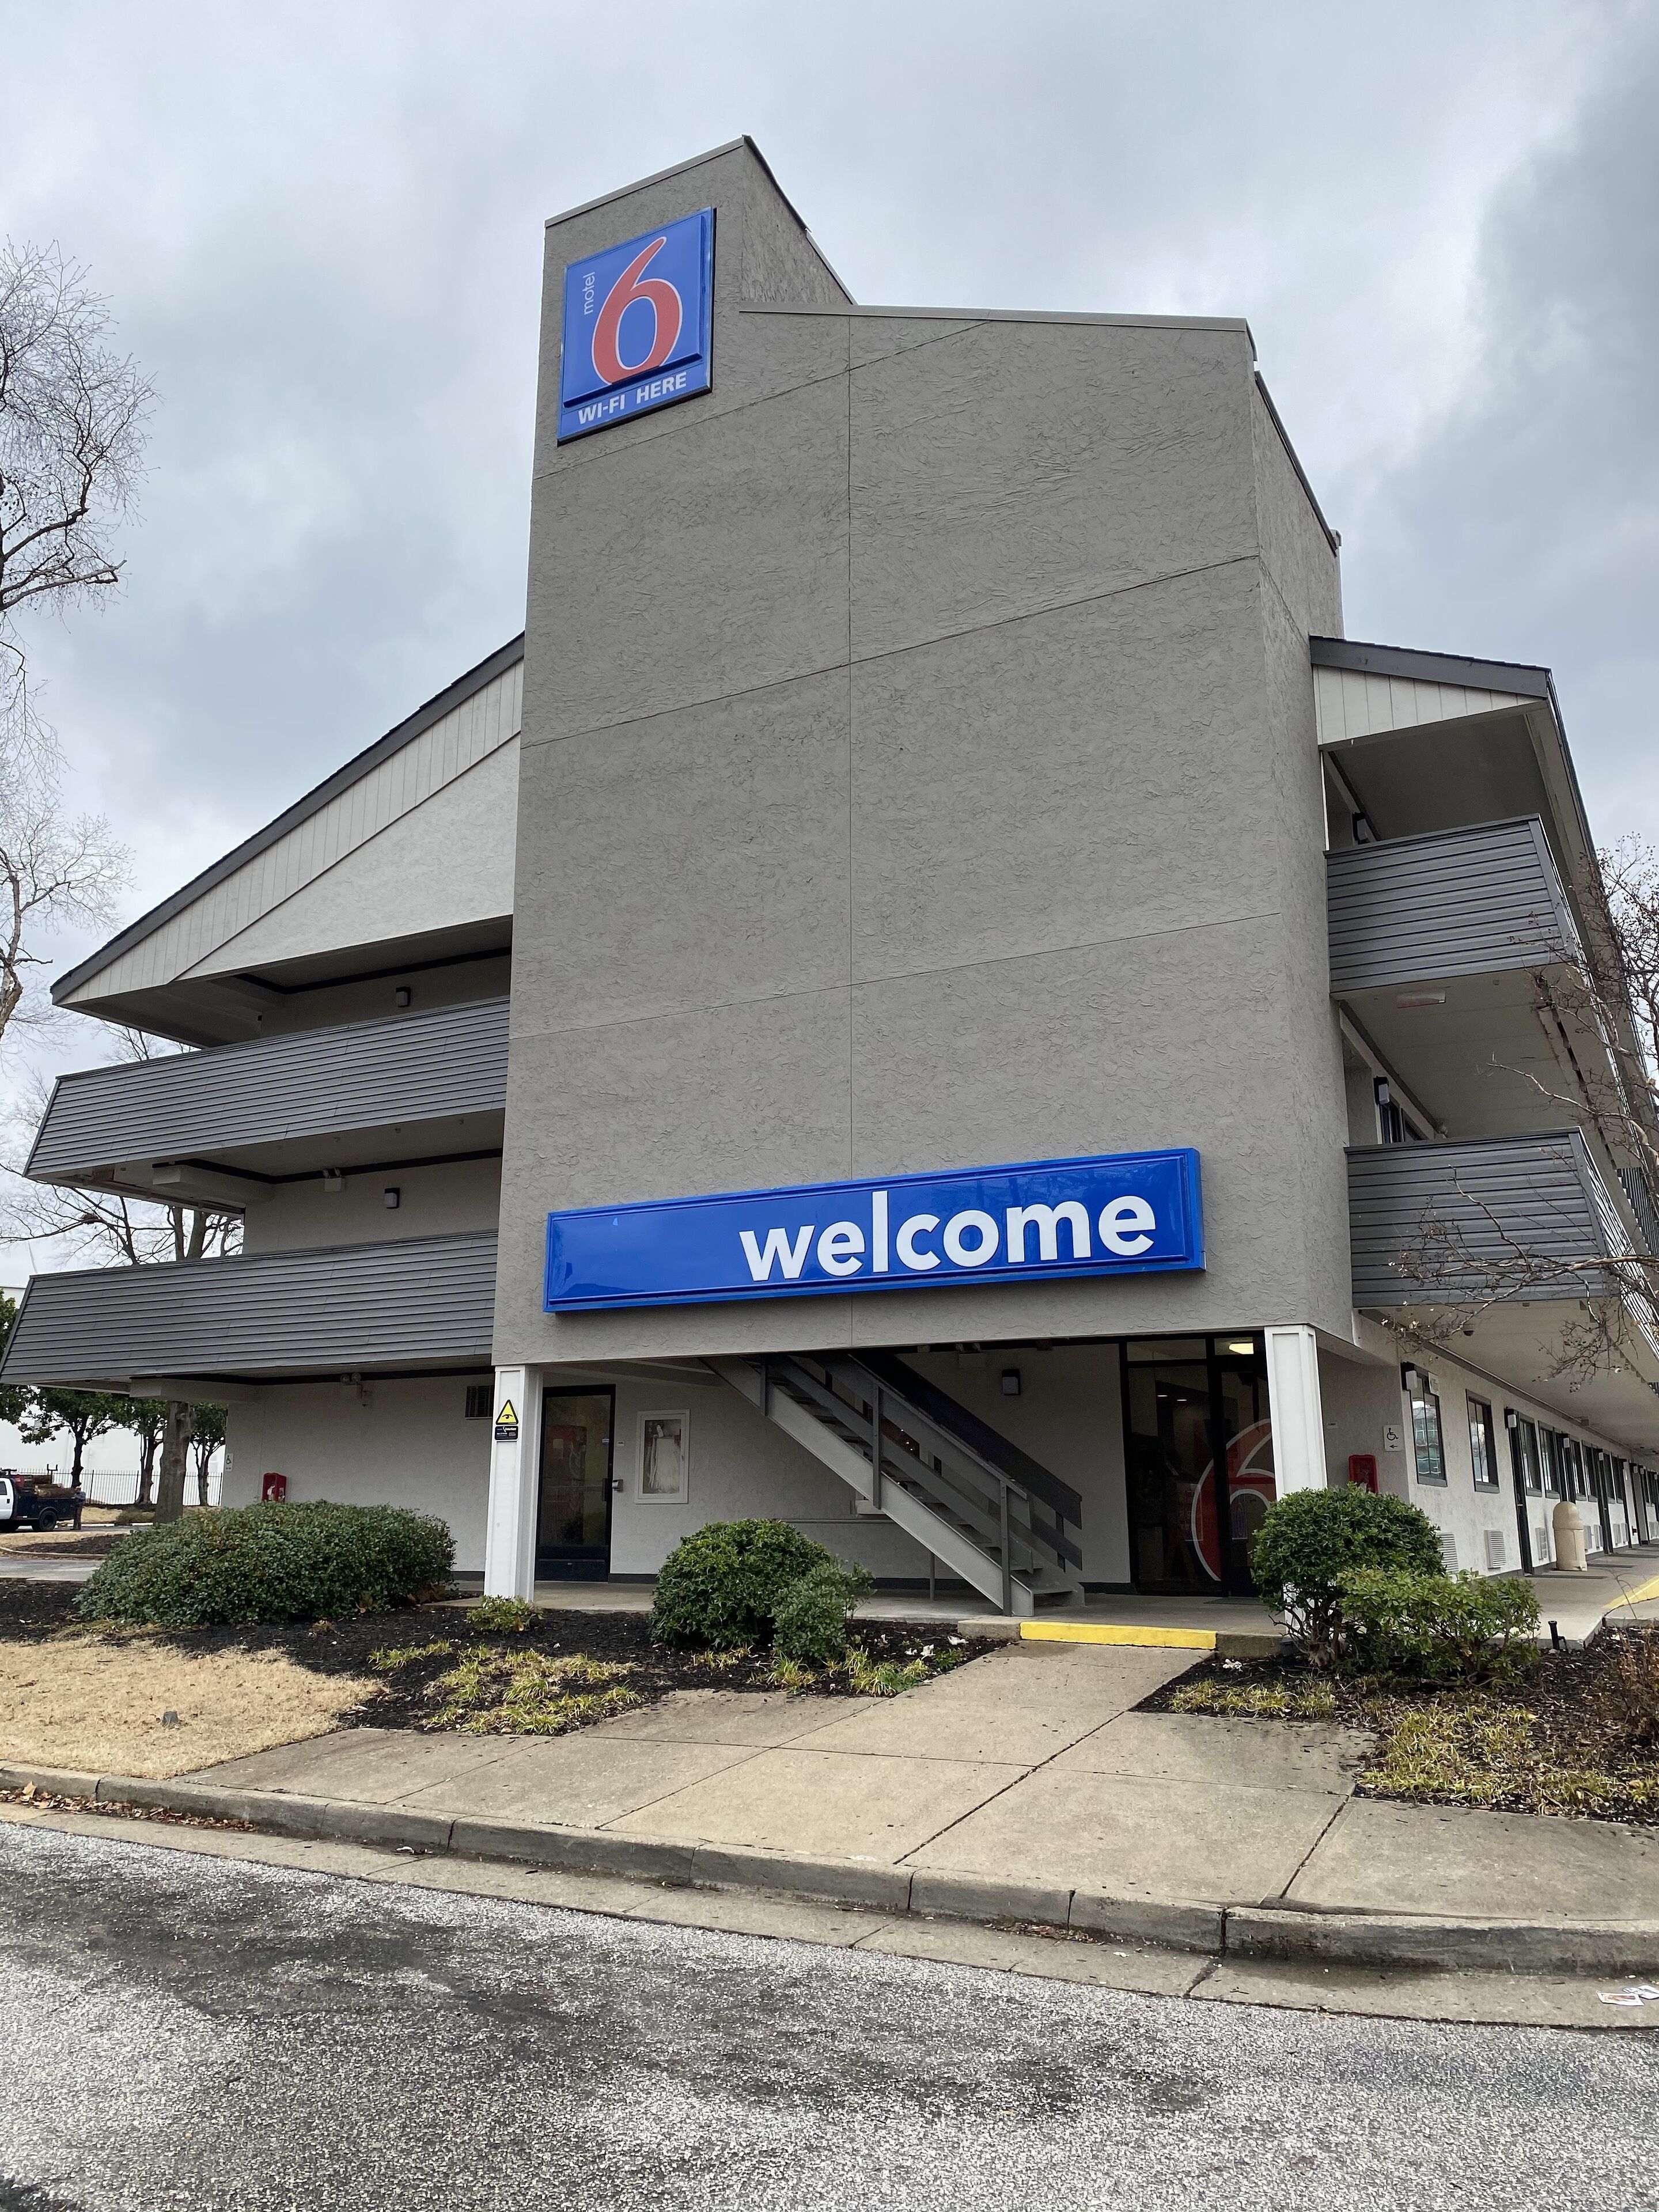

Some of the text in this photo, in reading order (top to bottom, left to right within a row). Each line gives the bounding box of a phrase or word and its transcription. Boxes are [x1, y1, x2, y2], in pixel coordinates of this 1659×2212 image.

[583, 272, 596, 315] motel
[592, 236, 683, 385] 6
[578, 372, 687, 424] WI-FI HERE
[738, 1191, 1157, 1282] welcome
